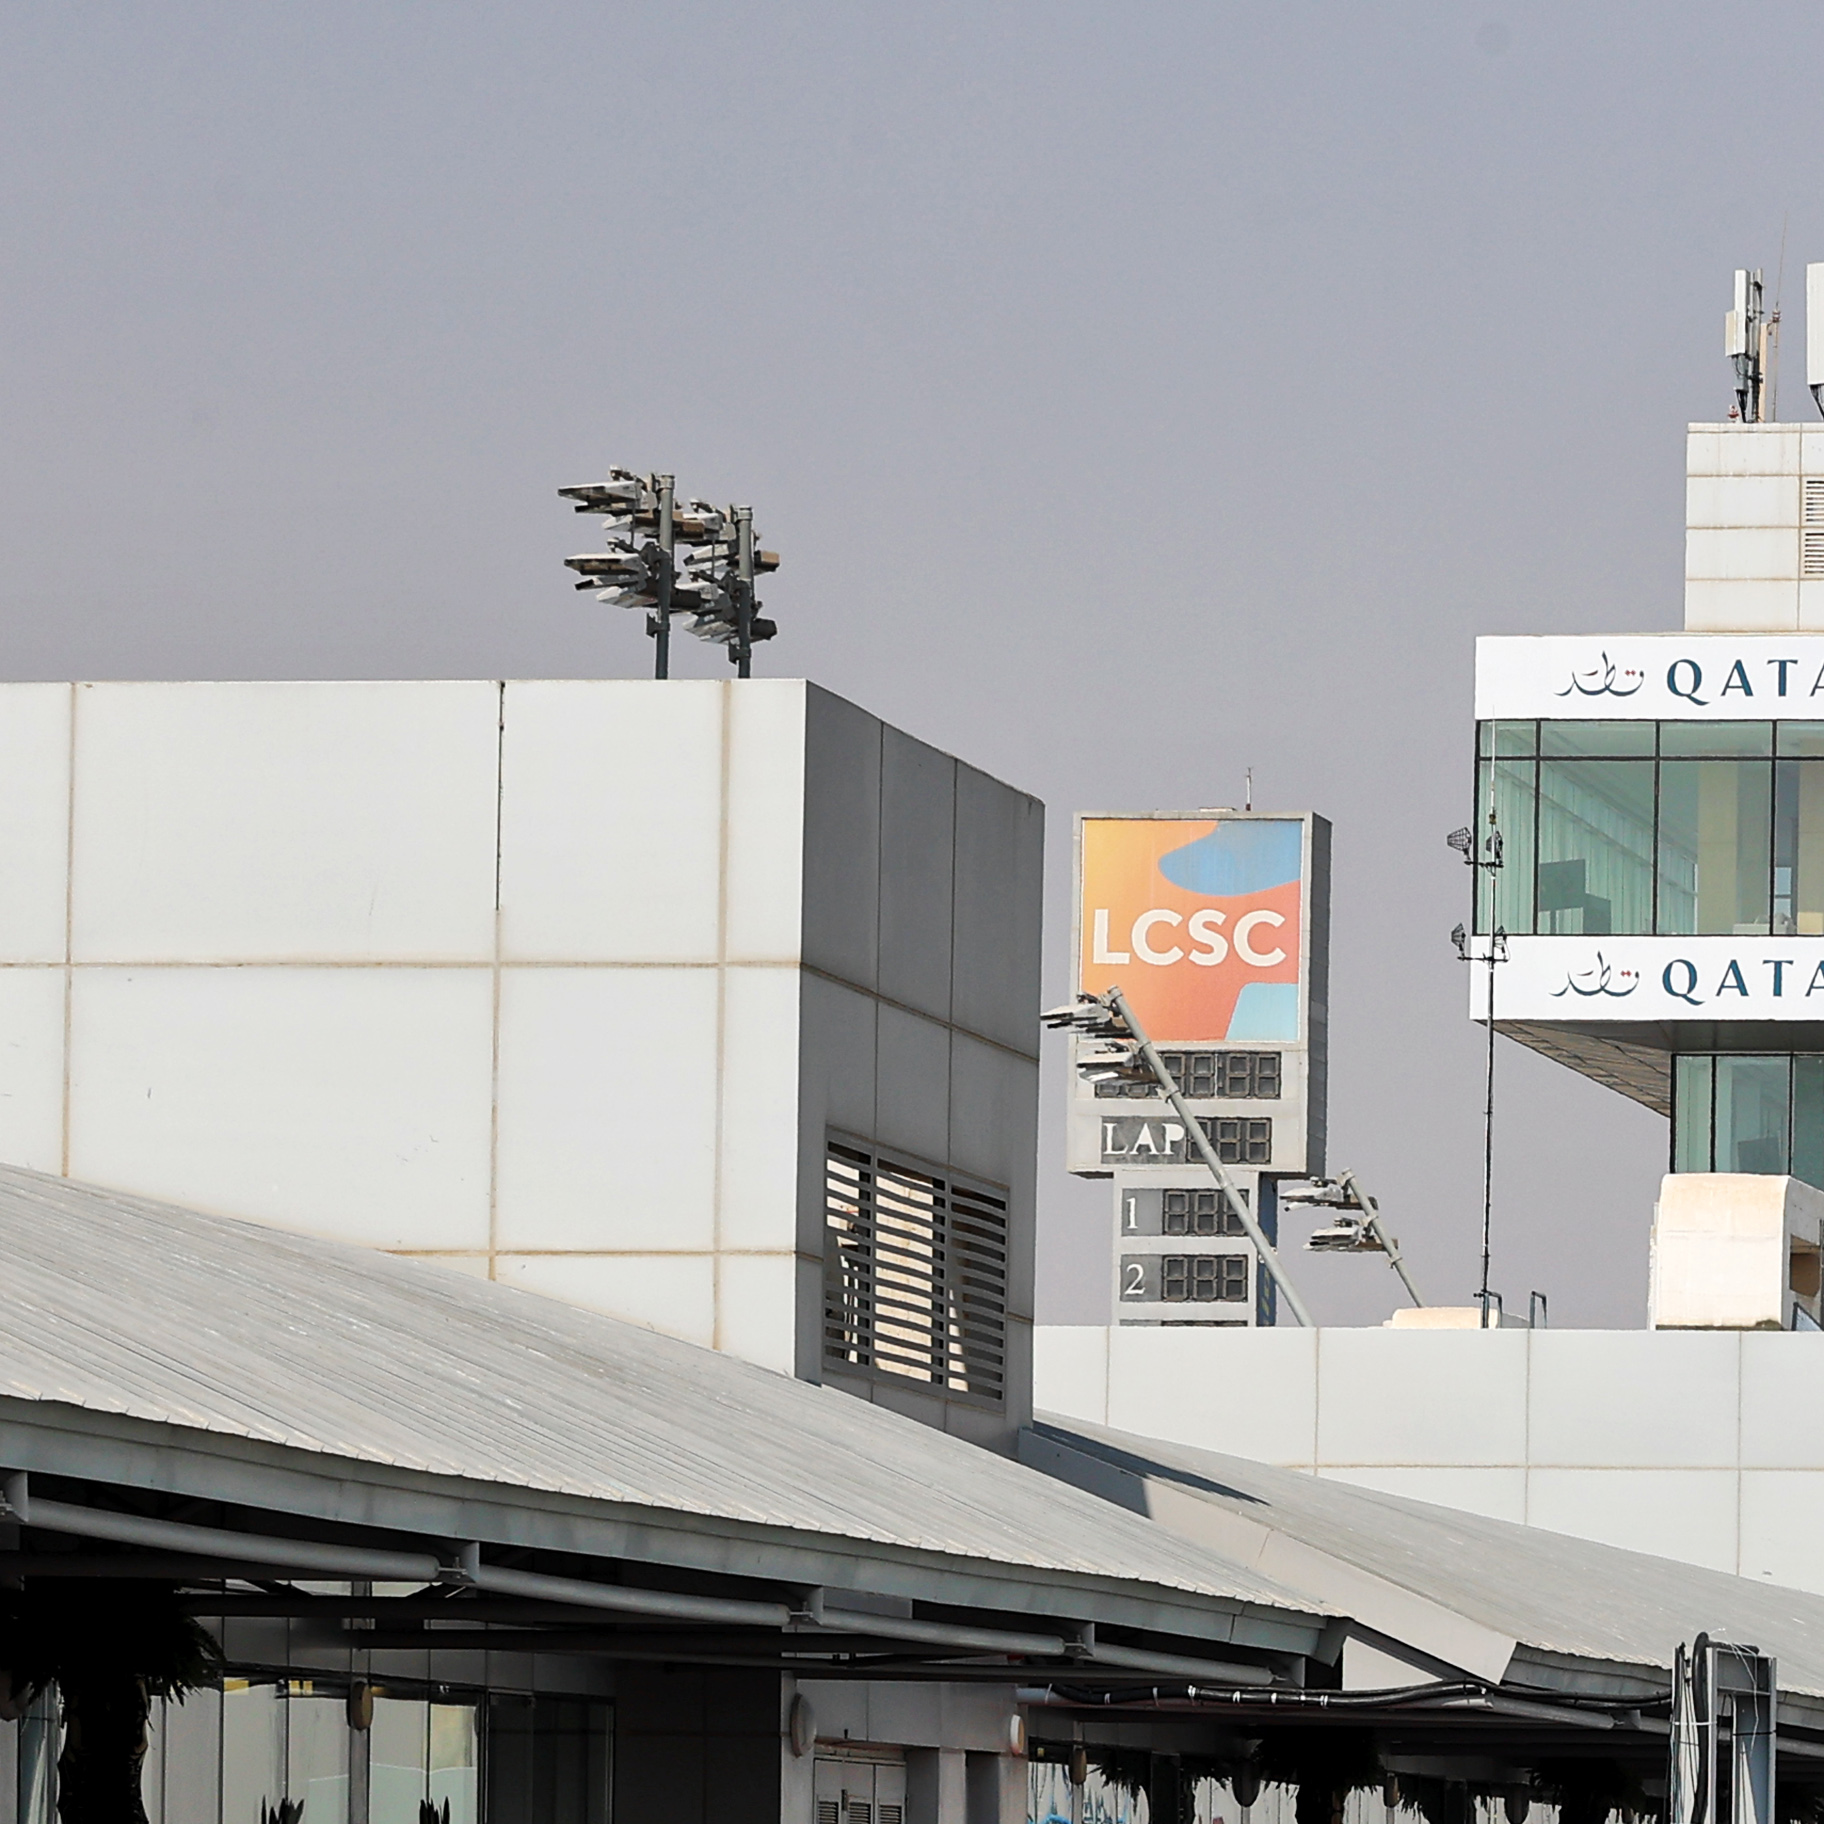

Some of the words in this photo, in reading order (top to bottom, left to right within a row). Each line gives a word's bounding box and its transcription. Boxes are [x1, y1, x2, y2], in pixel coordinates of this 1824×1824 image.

[1092, 908, 1286, 967] LCSC
[1103, 1123, 1185, 1156] LAP
[1126, 1198, 1139, 1229] 1
[1125, 1265, 1146, 1295] 2
